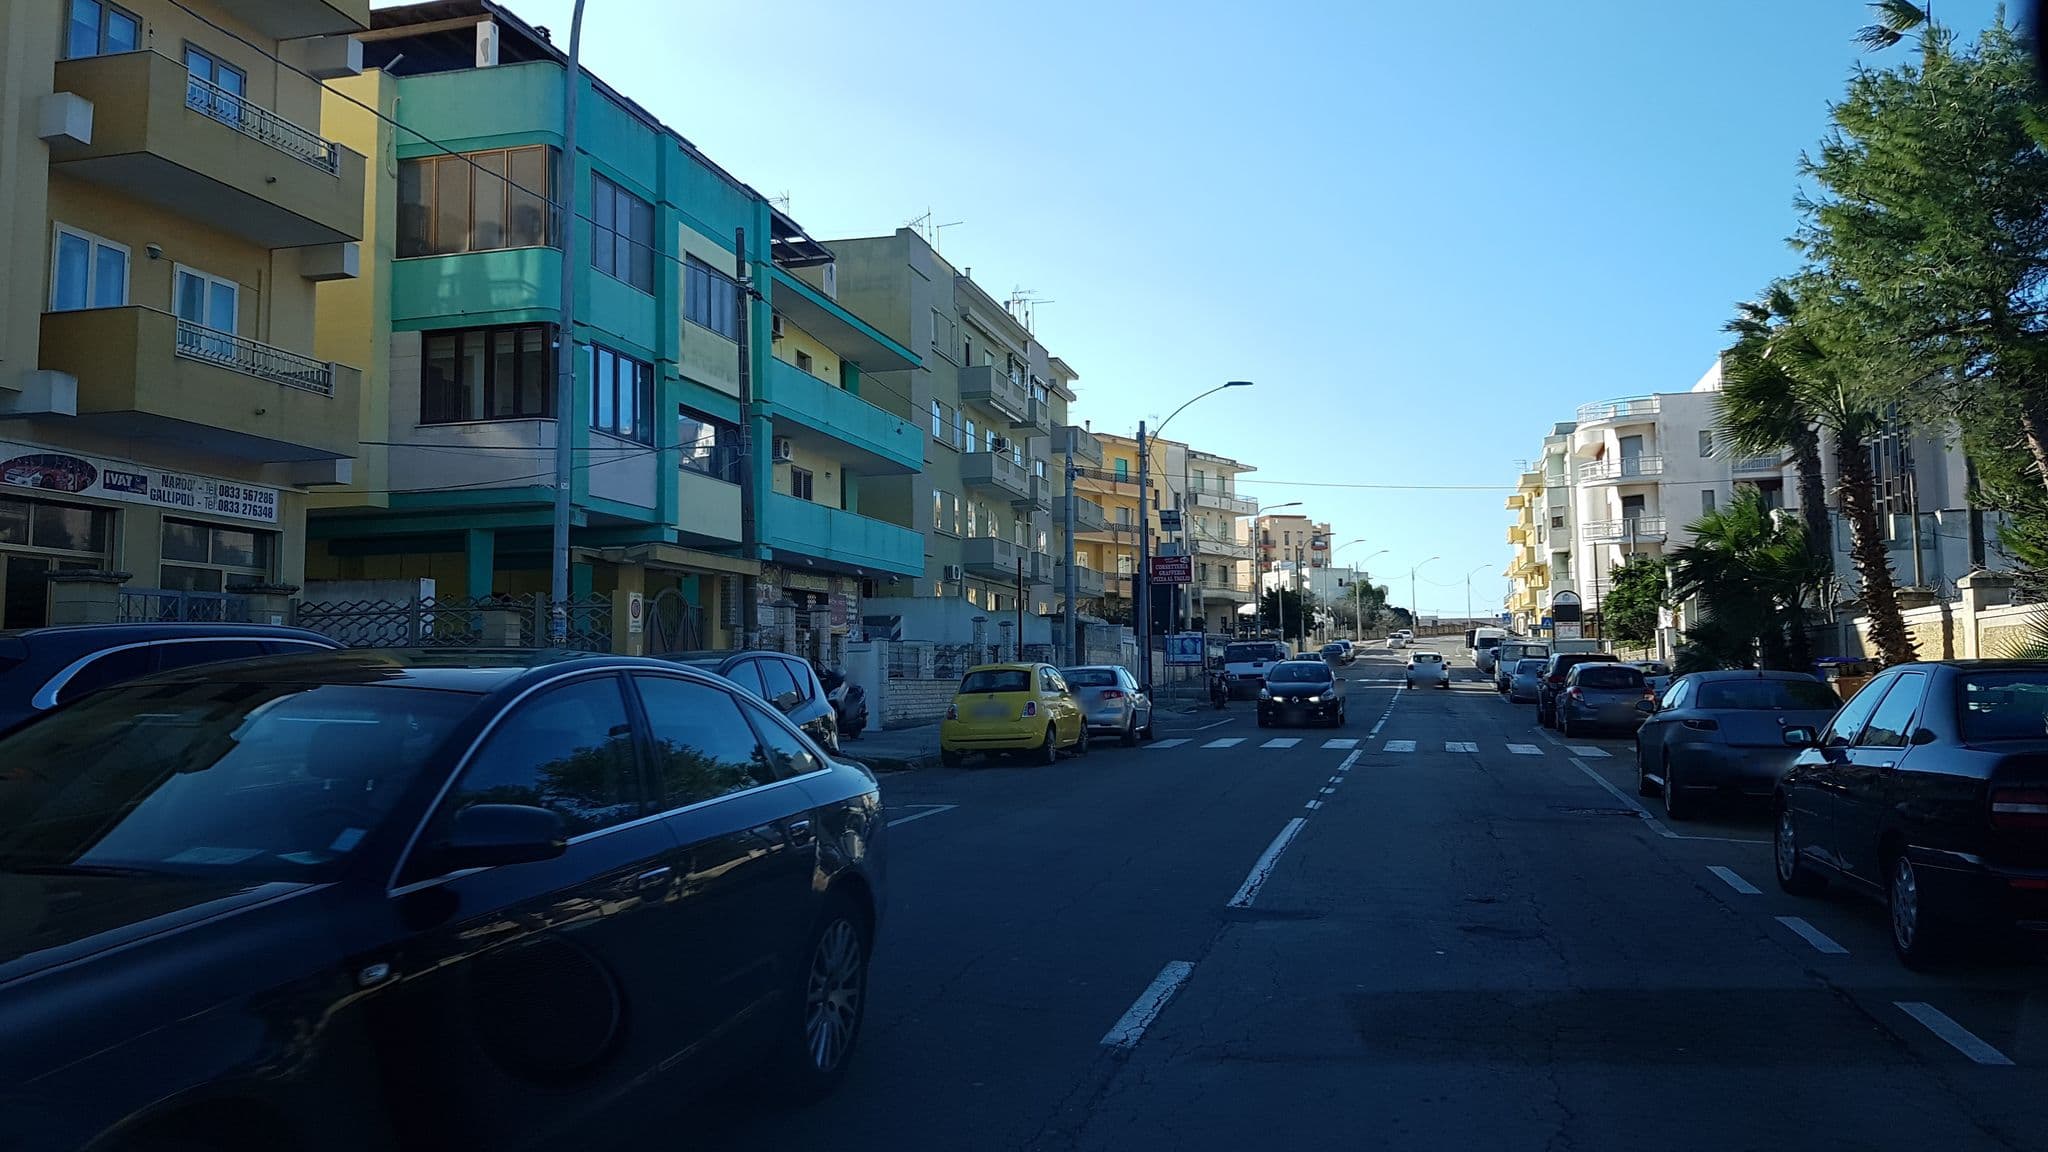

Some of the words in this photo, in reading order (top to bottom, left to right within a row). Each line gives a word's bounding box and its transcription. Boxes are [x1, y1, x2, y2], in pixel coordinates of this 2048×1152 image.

[149, 488, 194, 507] GALLIPOLI
[217, 499, 240, 514] 0833
[242, 504, 273, 519] 276348
[218, 484, 240, 500] 0833
[243, 489, 274, 505] 567286
